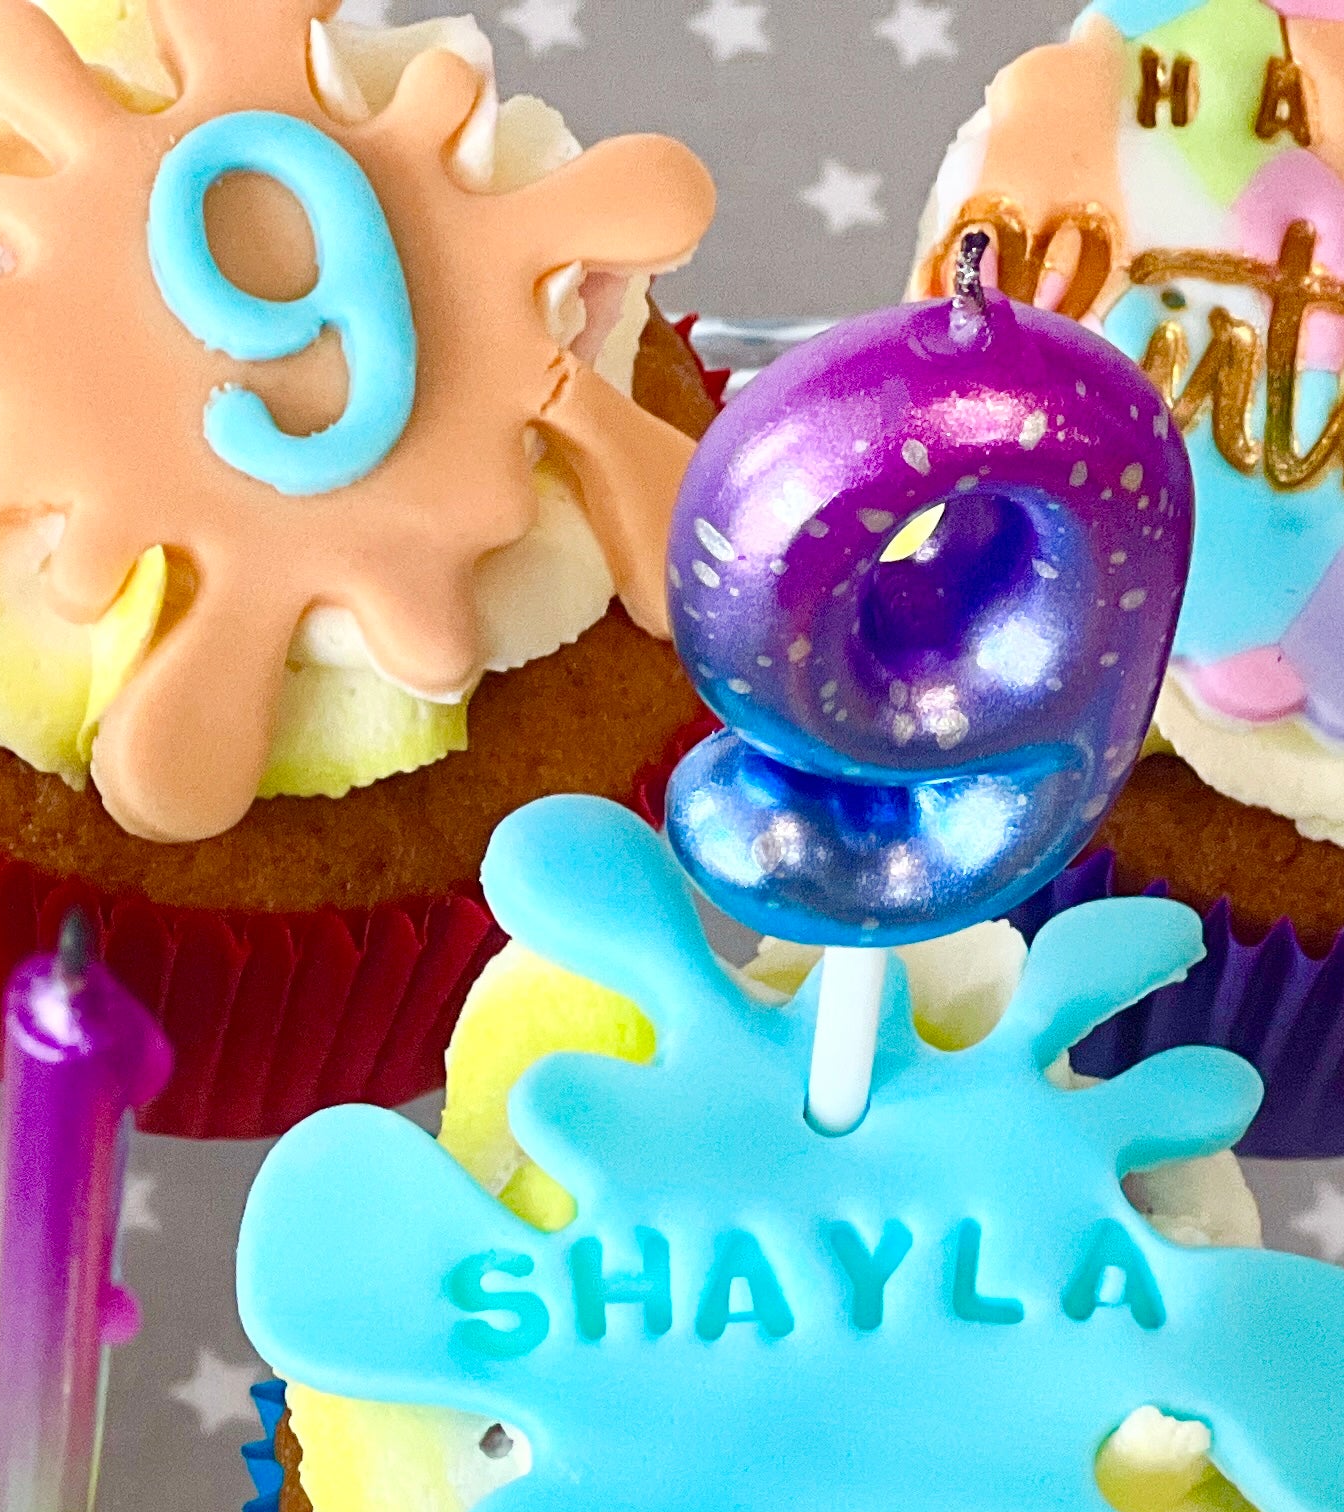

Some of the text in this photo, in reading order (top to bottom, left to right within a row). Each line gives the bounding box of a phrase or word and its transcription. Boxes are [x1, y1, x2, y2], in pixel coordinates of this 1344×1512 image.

[146, 110, 417, 496] 9
[666, 298, 1194, 948] 9
[449, 1216, 1168, 1356] SHAYLA
